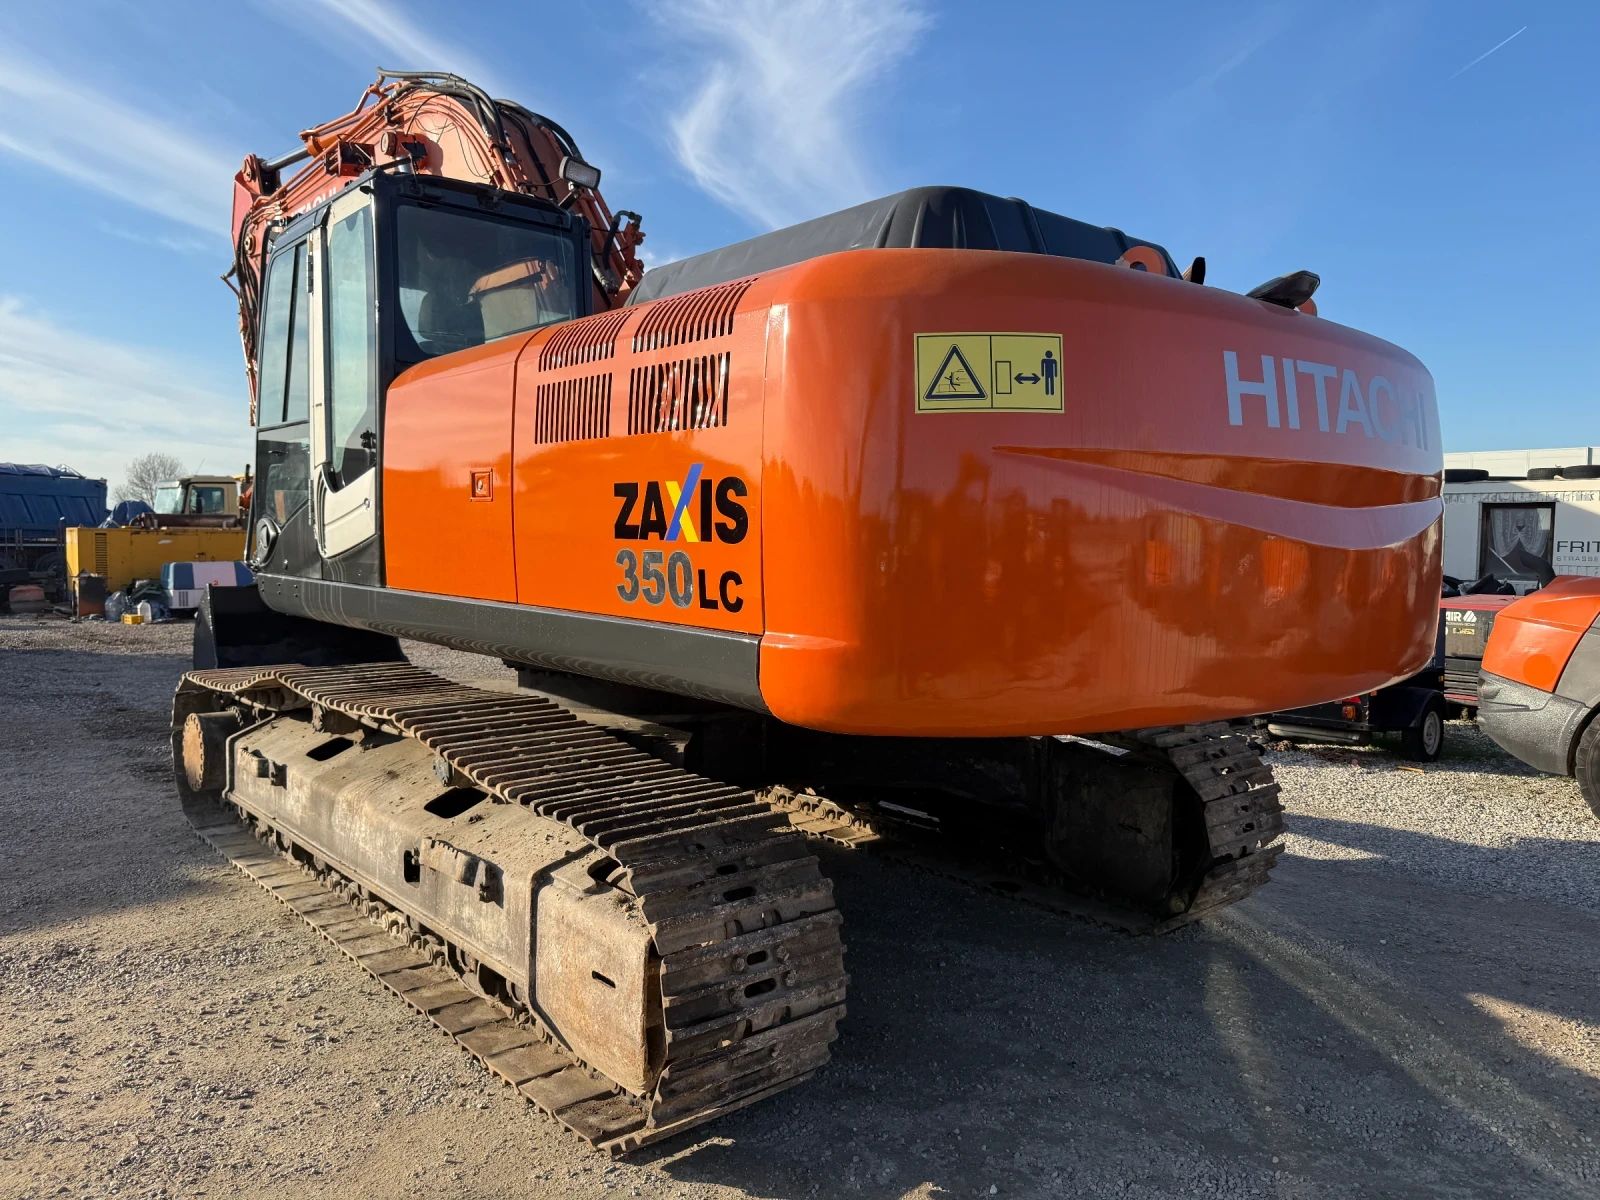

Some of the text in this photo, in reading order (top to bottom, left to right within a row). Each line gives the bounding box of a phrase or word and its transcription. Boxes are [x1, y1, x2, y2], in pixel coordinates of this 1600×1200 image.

[1223, 350, 1428, 451] HITACHI
[614, 463, 748, 544] ZAXIS
[615, 548, 743, 613] 350 LC
